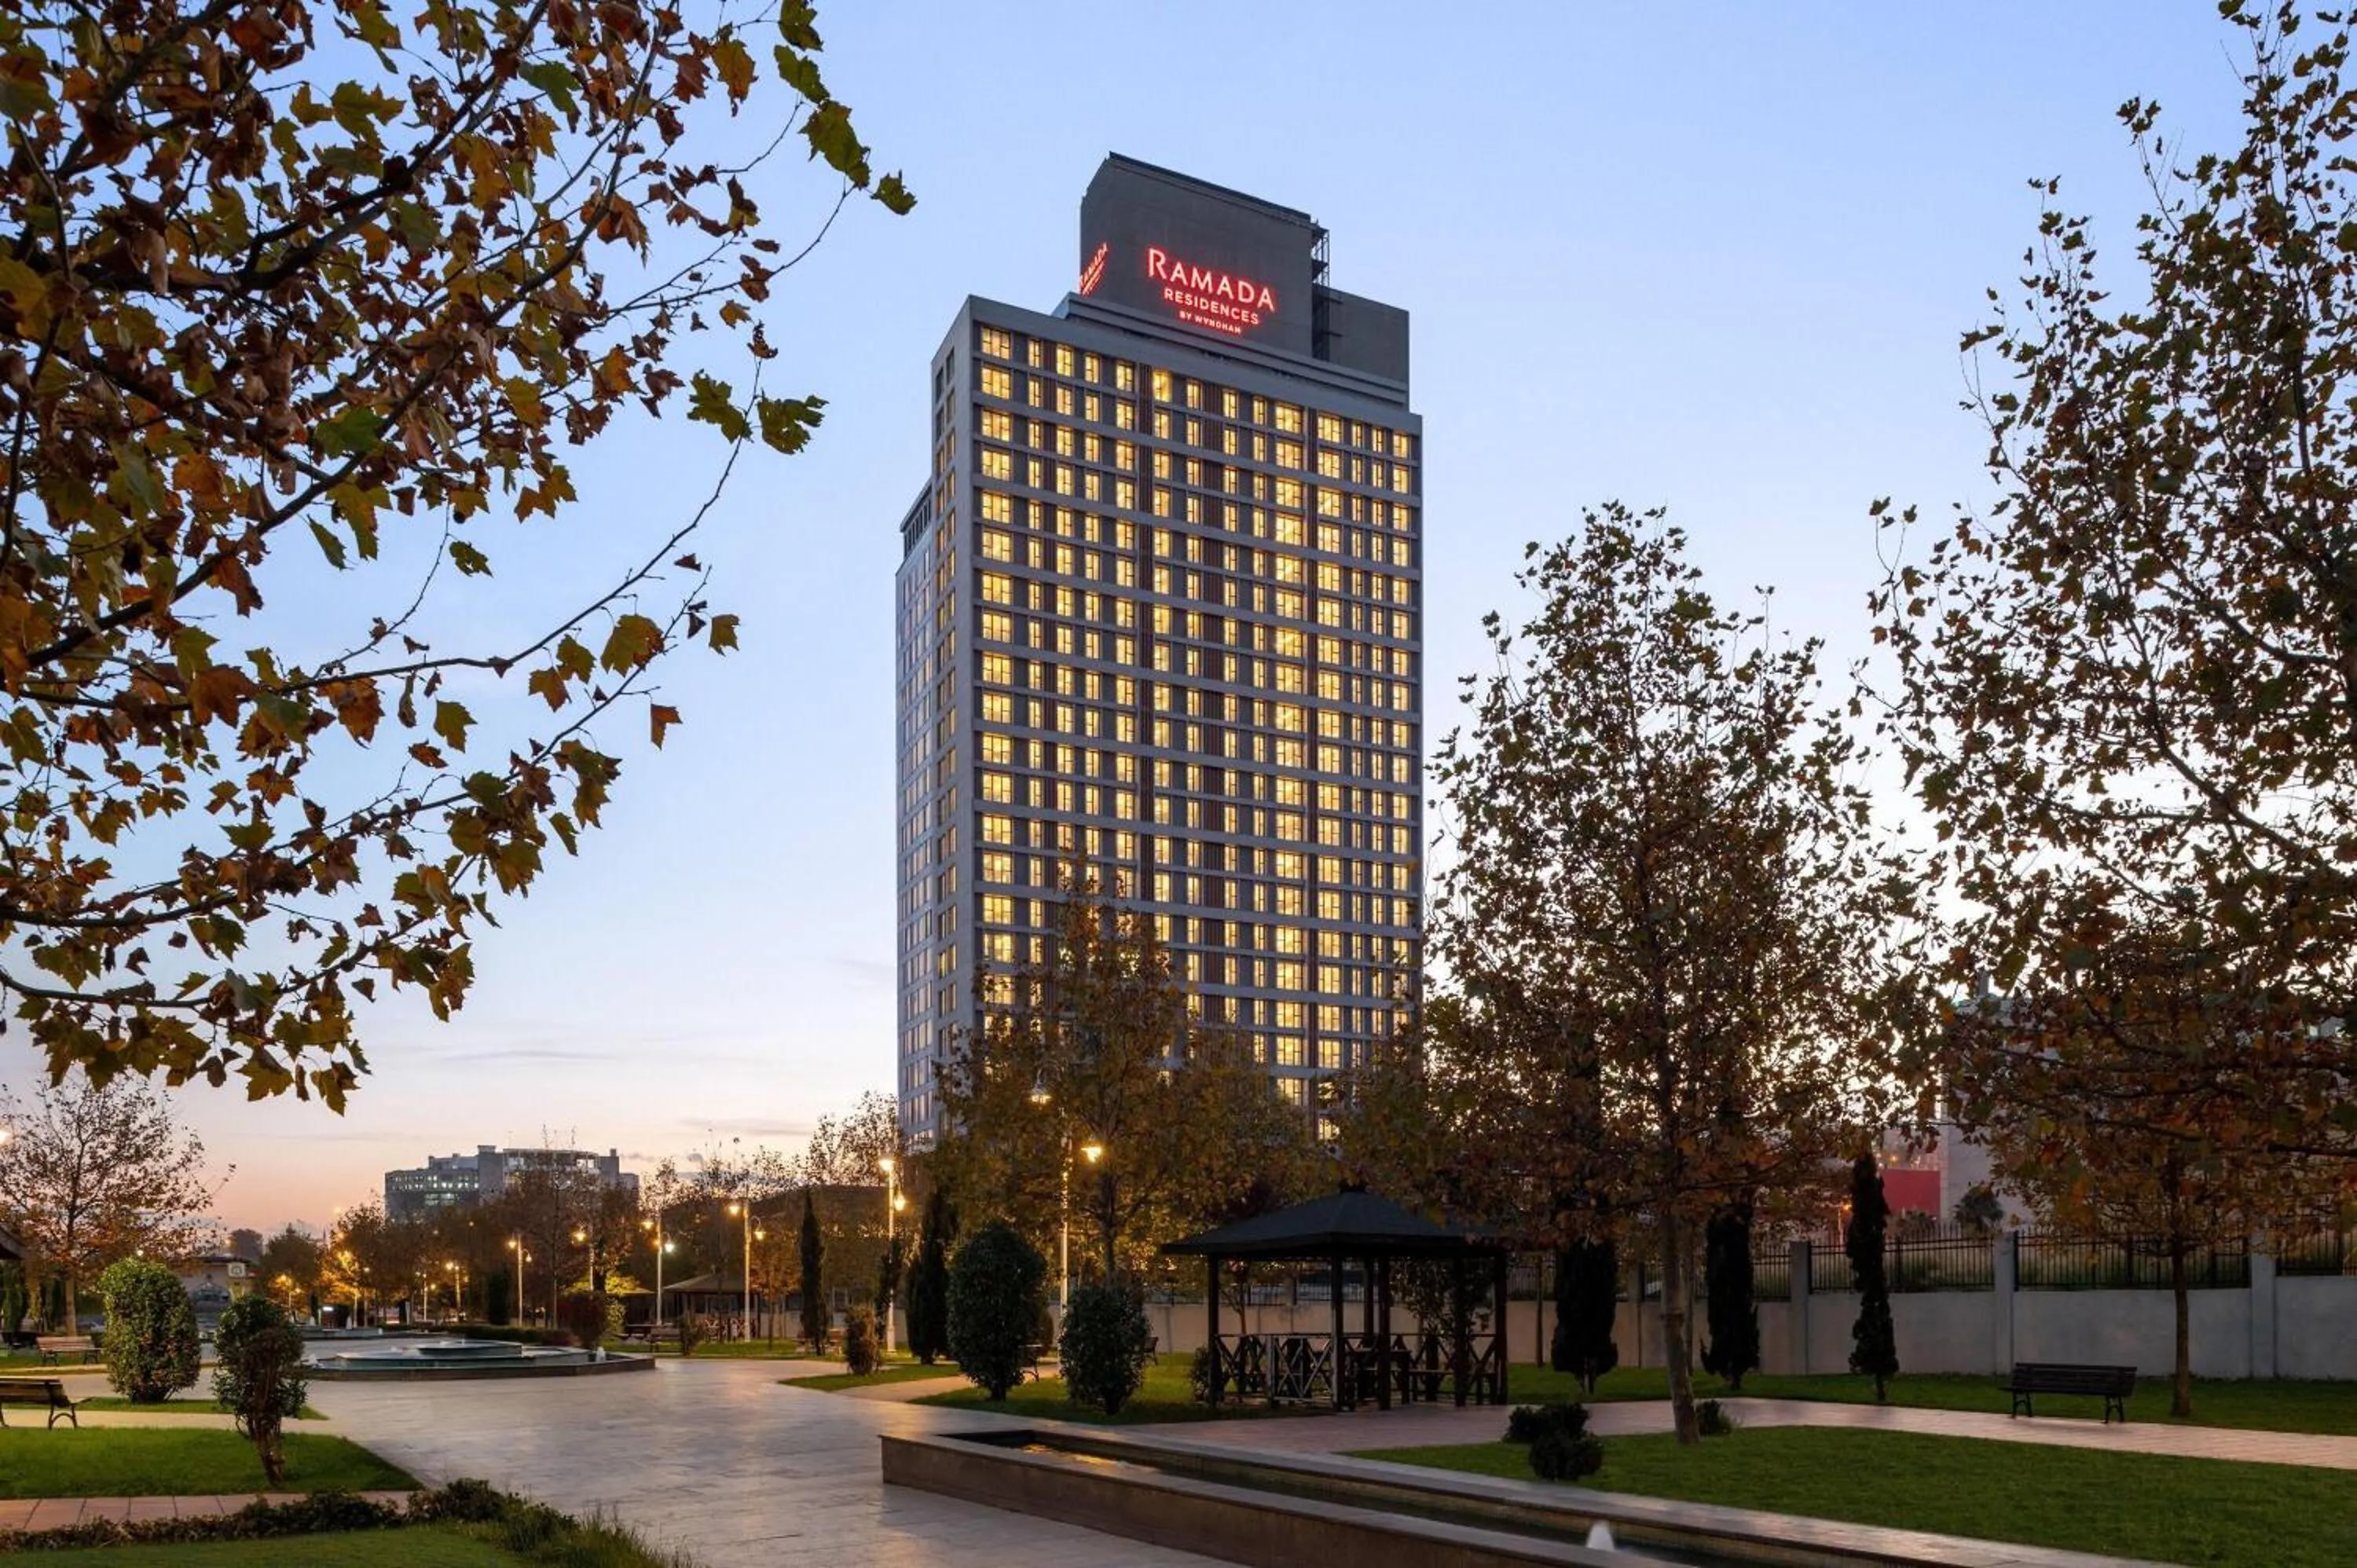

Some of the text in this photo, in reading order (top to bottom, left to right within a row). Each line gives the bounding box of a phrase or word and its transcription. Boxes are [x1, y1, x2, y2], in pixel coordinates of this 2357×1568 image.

[1148, 247, 1274, 312] RAMADA
[1164, 288, 1259, 324] RESIDENCES
[1179, 310, 1241, 335] BY WYNDHAM
